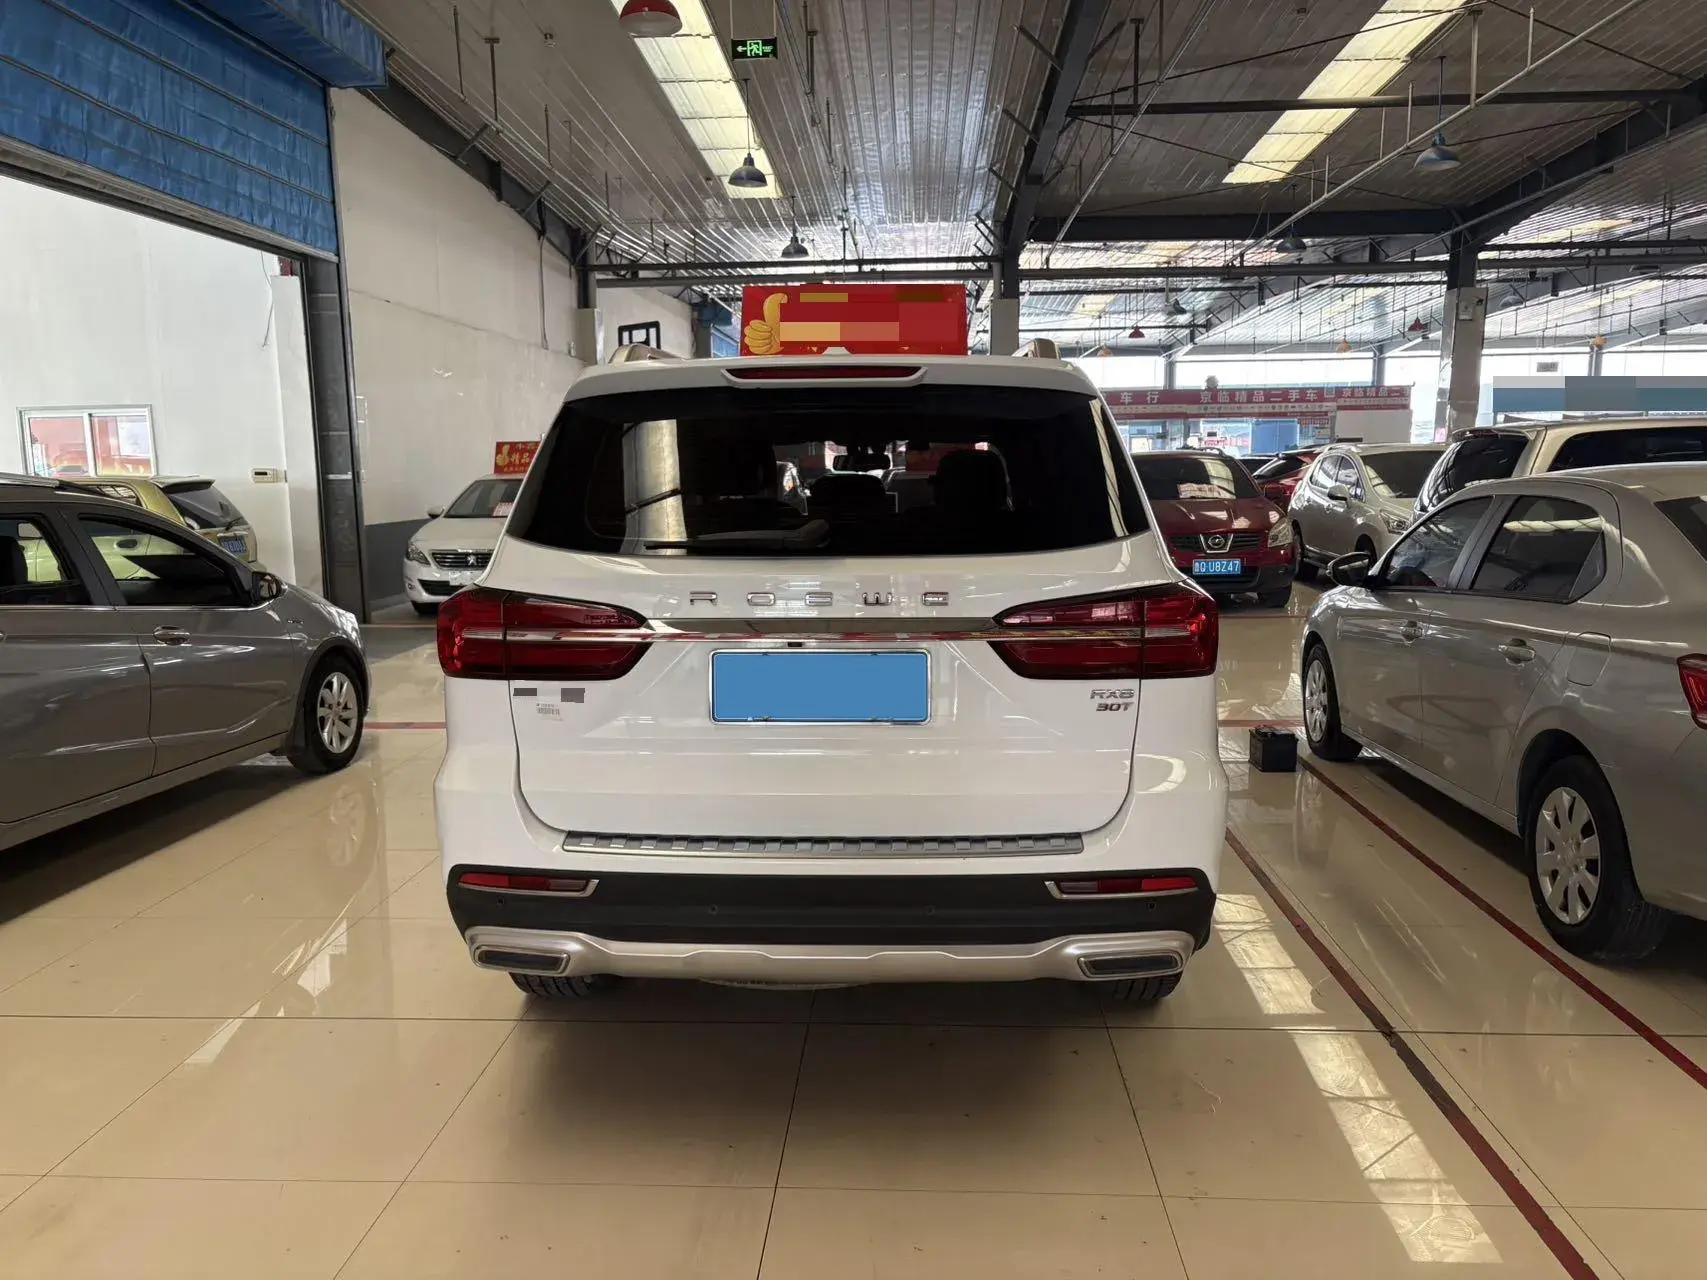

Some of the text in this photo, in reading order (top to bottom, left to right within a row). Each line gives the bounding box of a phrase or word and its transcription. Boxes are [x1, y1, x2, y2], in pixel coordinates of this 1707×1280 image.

[1103, 391, 1160, 404] 车行
[1200, 389, 1318, 404] 京临精品二手车
[689, 591, 949, 607] ROEWE
[1090, 688, 1135, 699] RX8
[1096, 702, 1134, 712] 30T
